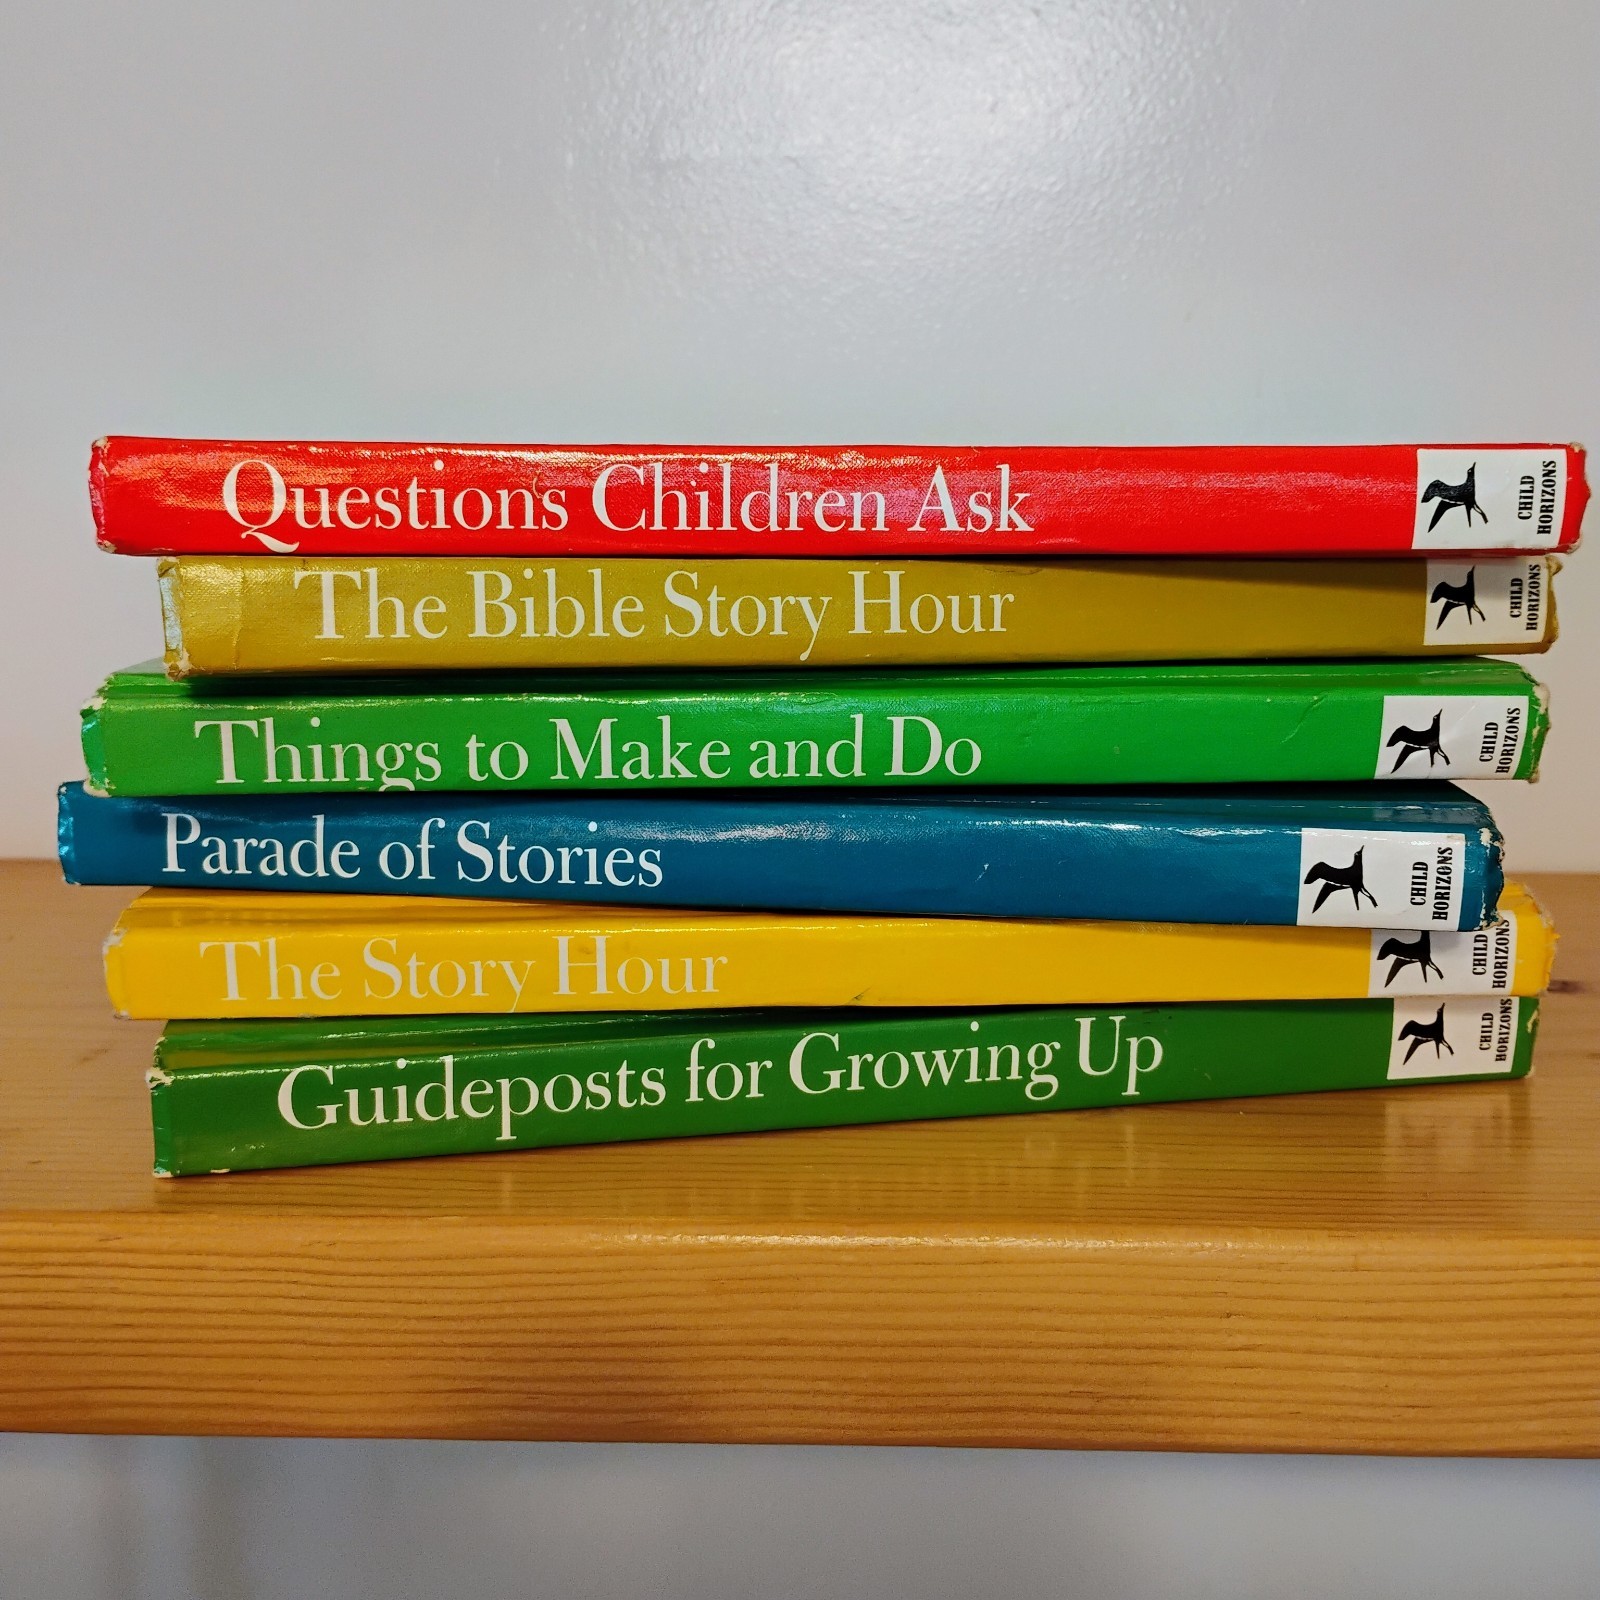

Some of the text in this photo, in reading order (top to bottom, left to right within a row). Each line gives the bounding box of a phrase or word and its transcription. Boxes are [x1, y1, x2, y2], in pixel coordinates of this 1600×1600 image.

[222, 459, 1036, 553] Questions Children Ask
[1517, 475, 1535, 520] CHILD
[1536, 460, 1557, 535] HORIZONS
[294, 567, 1015, 661] The Bible Story Hour
[1509, 577, 1524, 618] CHILD
[1525, 564, 1541, 631] HORIZONS
[195, 714, 982, 791] Things to Make and Do
[1479, 721, 1499, 762] CHILD
[1495, 707, 1521, 774] HORIZONS
[161, 812, 663, 887] Parade of Stories
[1410, 861, 1429, 906] CHILD
[1432, 846, 1454, 921] HORIZONS
[199, 934, 728, 1013] The Story Hour
[1472, 933, 1489, 976] CHILD
[1492, 919, 1510, 989] HORIZONS
[1479, 1012, 1494, 1051] CHILD
[1495, 998, 1513, 1062] HORIZONS
[277, 1015, 1164, 1140] Guideposts for Growing Up
